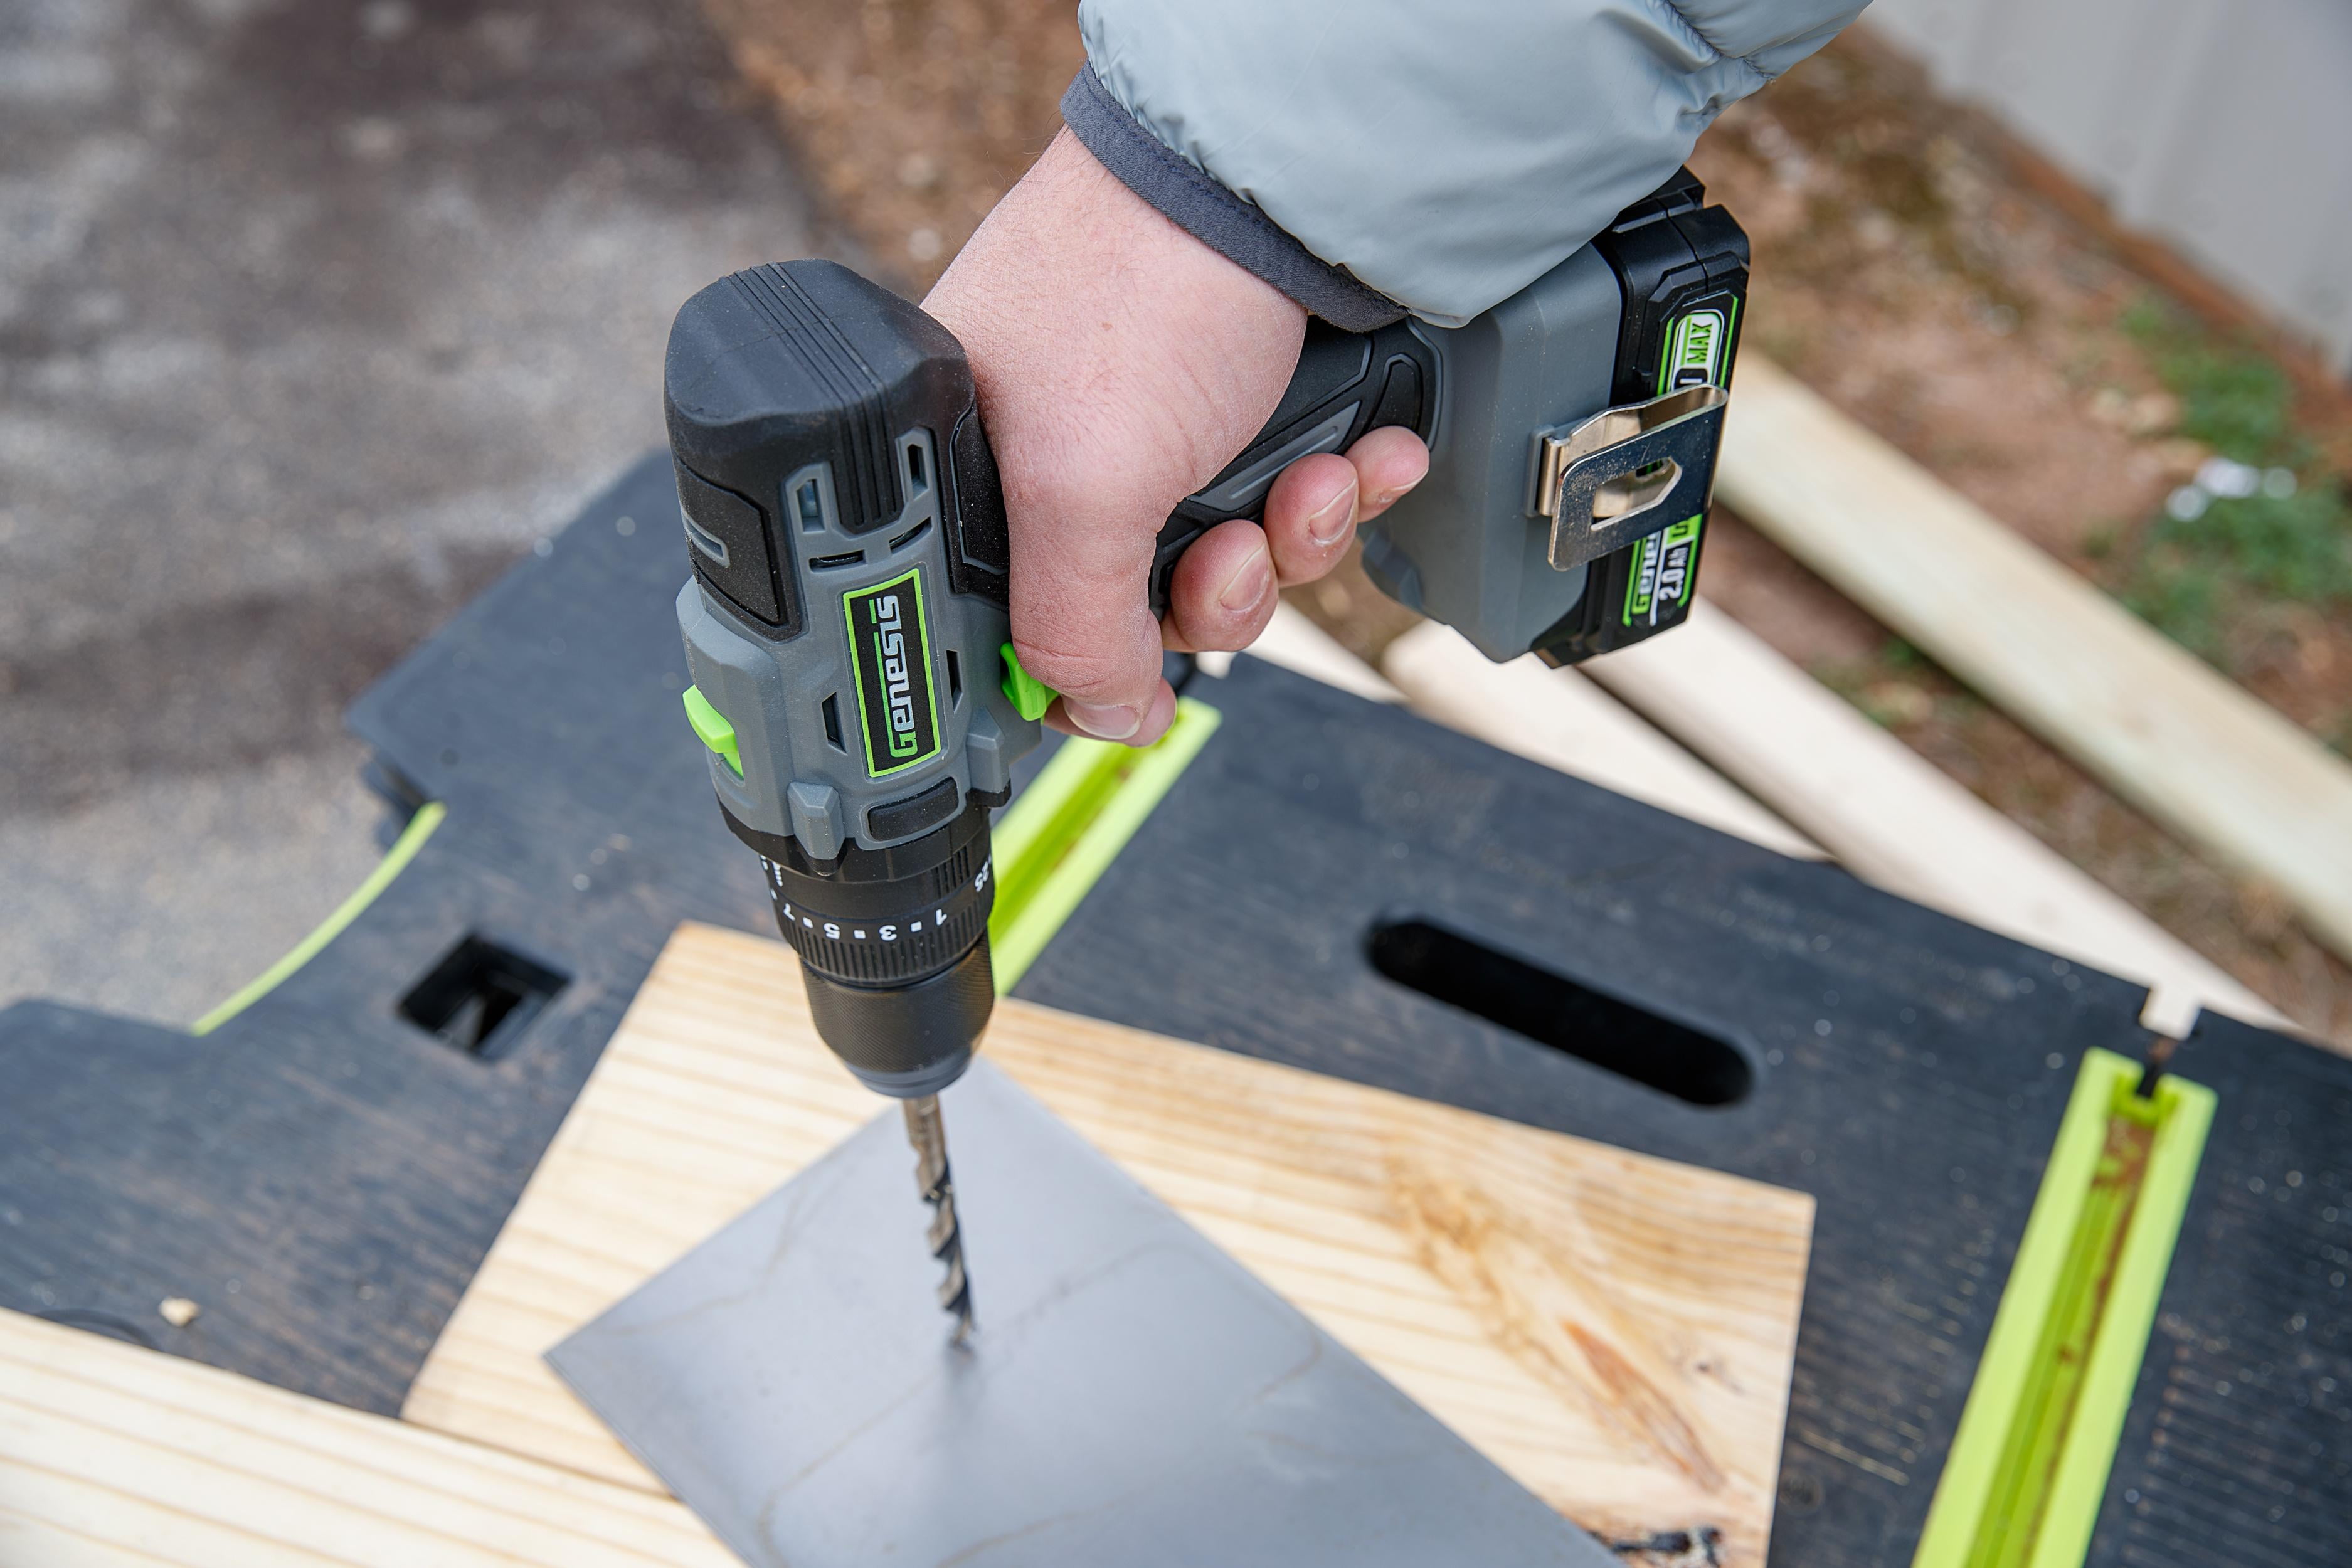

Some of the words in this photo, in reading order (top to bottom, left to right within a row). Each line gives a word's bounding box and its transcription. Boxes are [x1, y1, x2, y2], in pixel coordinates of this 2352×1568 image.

[1687, 323, 1713, 364] MAX
[975, 861, 989, 893] 25
[783, 903, 796, 921] 7
[935, 909, 948, 926] 1
[824, 923, 840, 940] 5
[879, 925, 897, 941] 3
